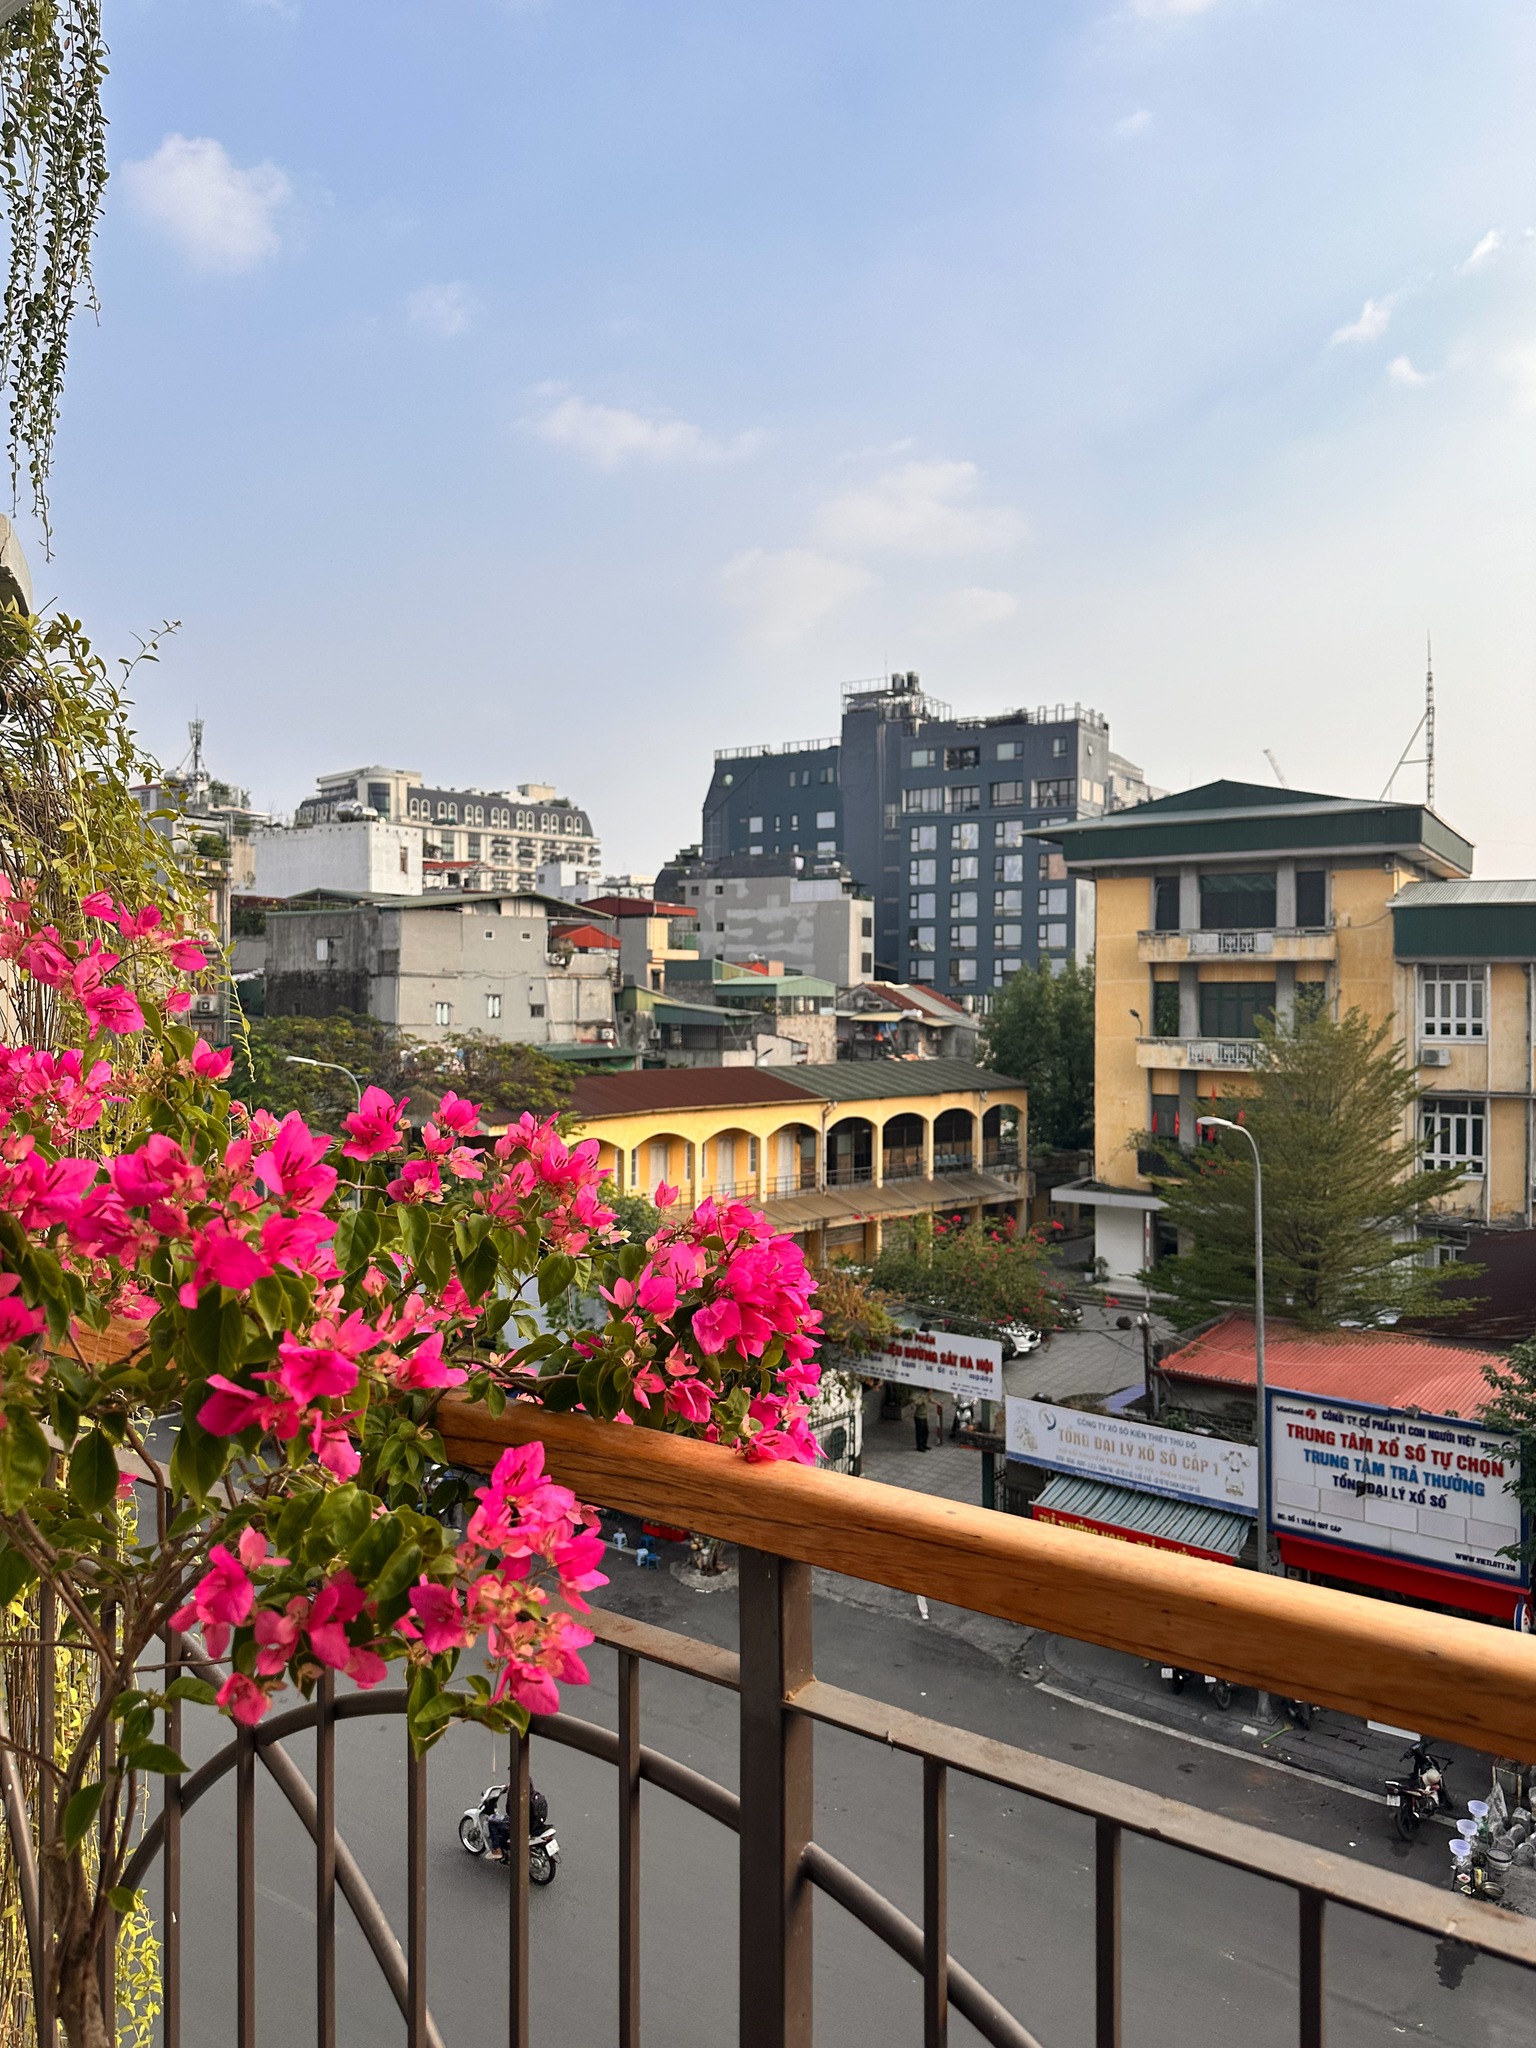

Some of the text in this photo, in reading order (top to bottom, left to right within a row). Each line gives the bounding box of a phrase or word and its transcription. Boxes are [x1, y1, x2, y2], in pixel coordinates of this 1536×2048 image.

[1098, 1422, 1106, 1431] TY
[1408, 1426, 1426, 1438] CON
[1457, 1434, 1476, 1448] VIỆT
[1094, 1436, 1115, 1455] ĐẠI
[1120, 1441, 1134, 1457] LÝ
[1286, 1422, 1504, 1478] TRUNG TÂM XỔ SỐ TỰ CHỌN
[1303, 1448, 1486, 1497] TRUNG TÂM TRẢ THƯỞNG
[1366, 1483, 1388, 1498] ĐẠI
[1392, 1486, 1405, 1500] LÝ
[1430, 1493, 1448, 1509] SỐ
